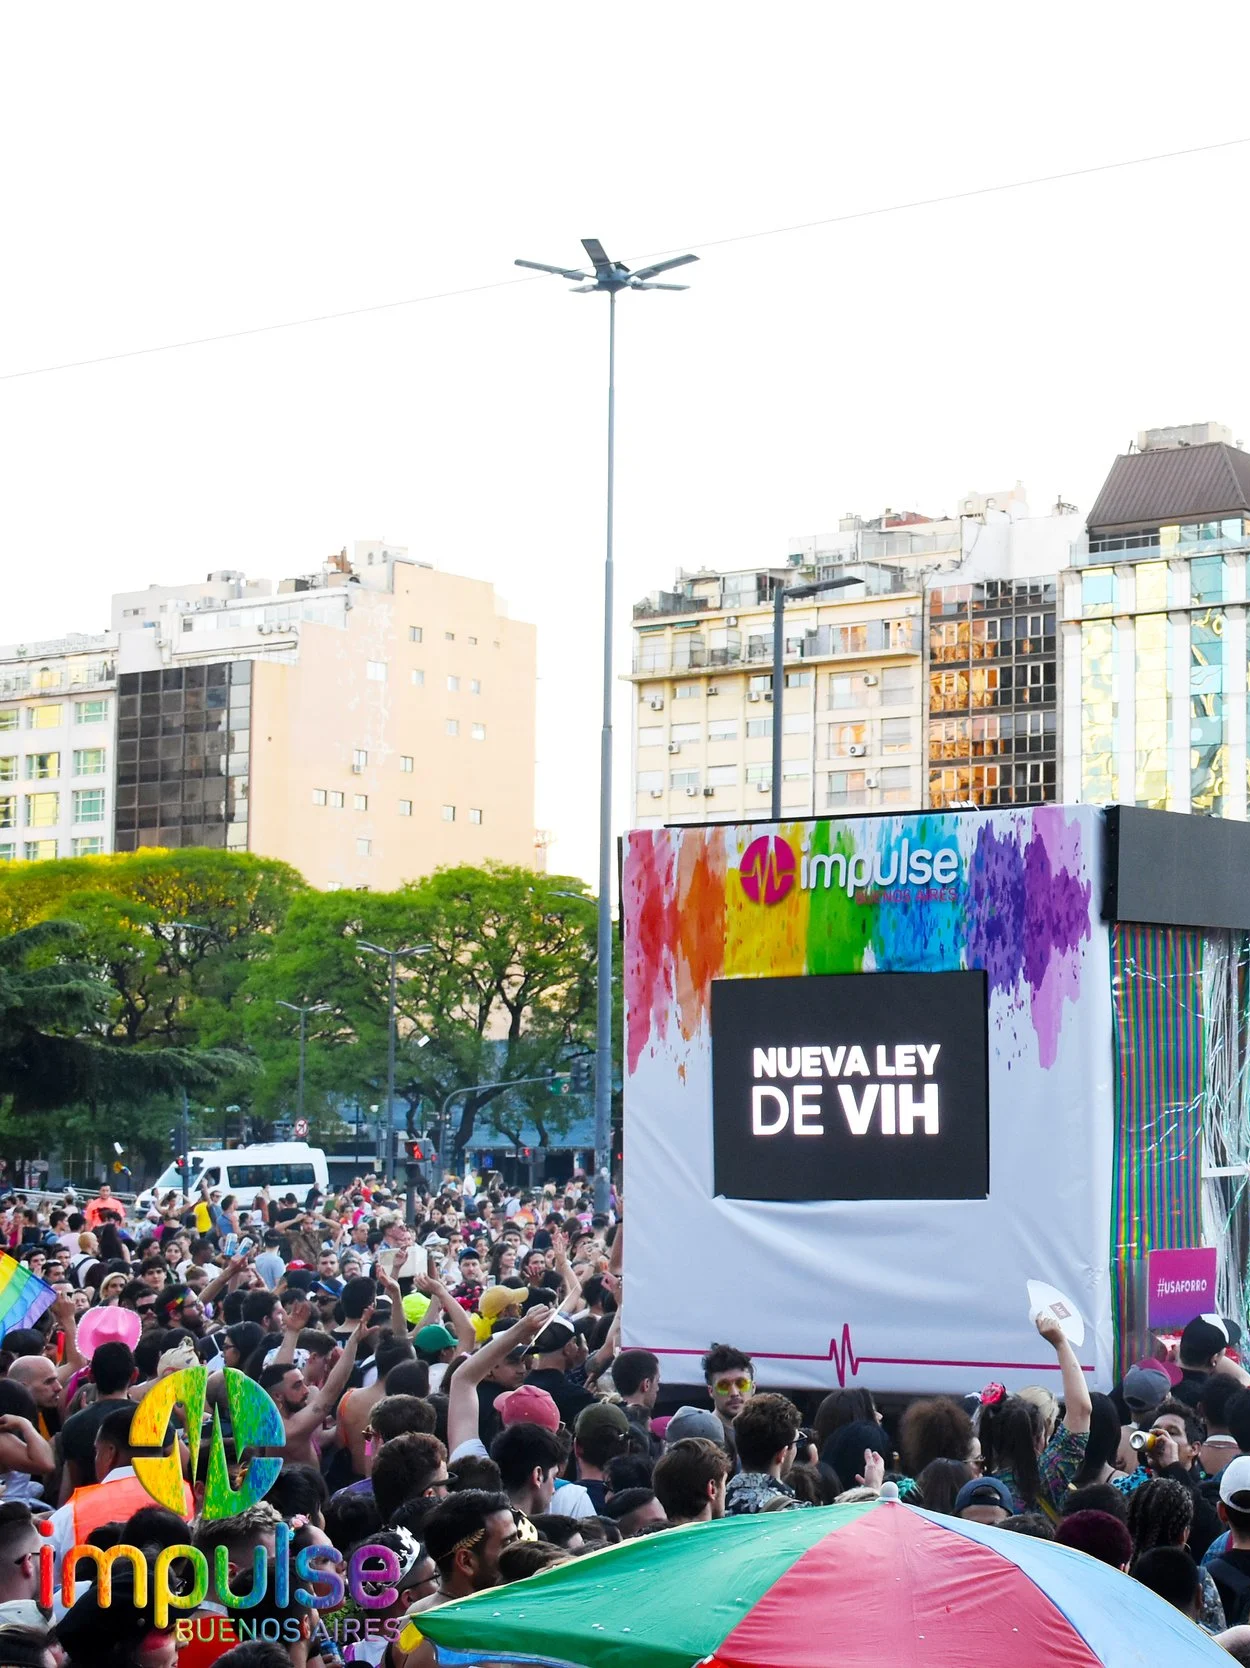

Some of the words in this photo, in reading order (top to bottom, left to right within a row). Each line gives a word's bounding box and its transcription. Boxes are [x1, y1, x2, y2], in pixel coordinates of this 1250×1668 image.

[801, 838, 958, 897] impulse
[855, 891, 911, 905] BUENOS
[915, 887, 958, 903] AIRES
[753, 1045, 870, 1078] NUEVA
[877, 1044, 941, 1076] LEY
[752, 1085, 824, 1136] DE
[837, 1083, 939, 1135] VIH
[1157, 1278, 1207, 1298] #USAFORRO
